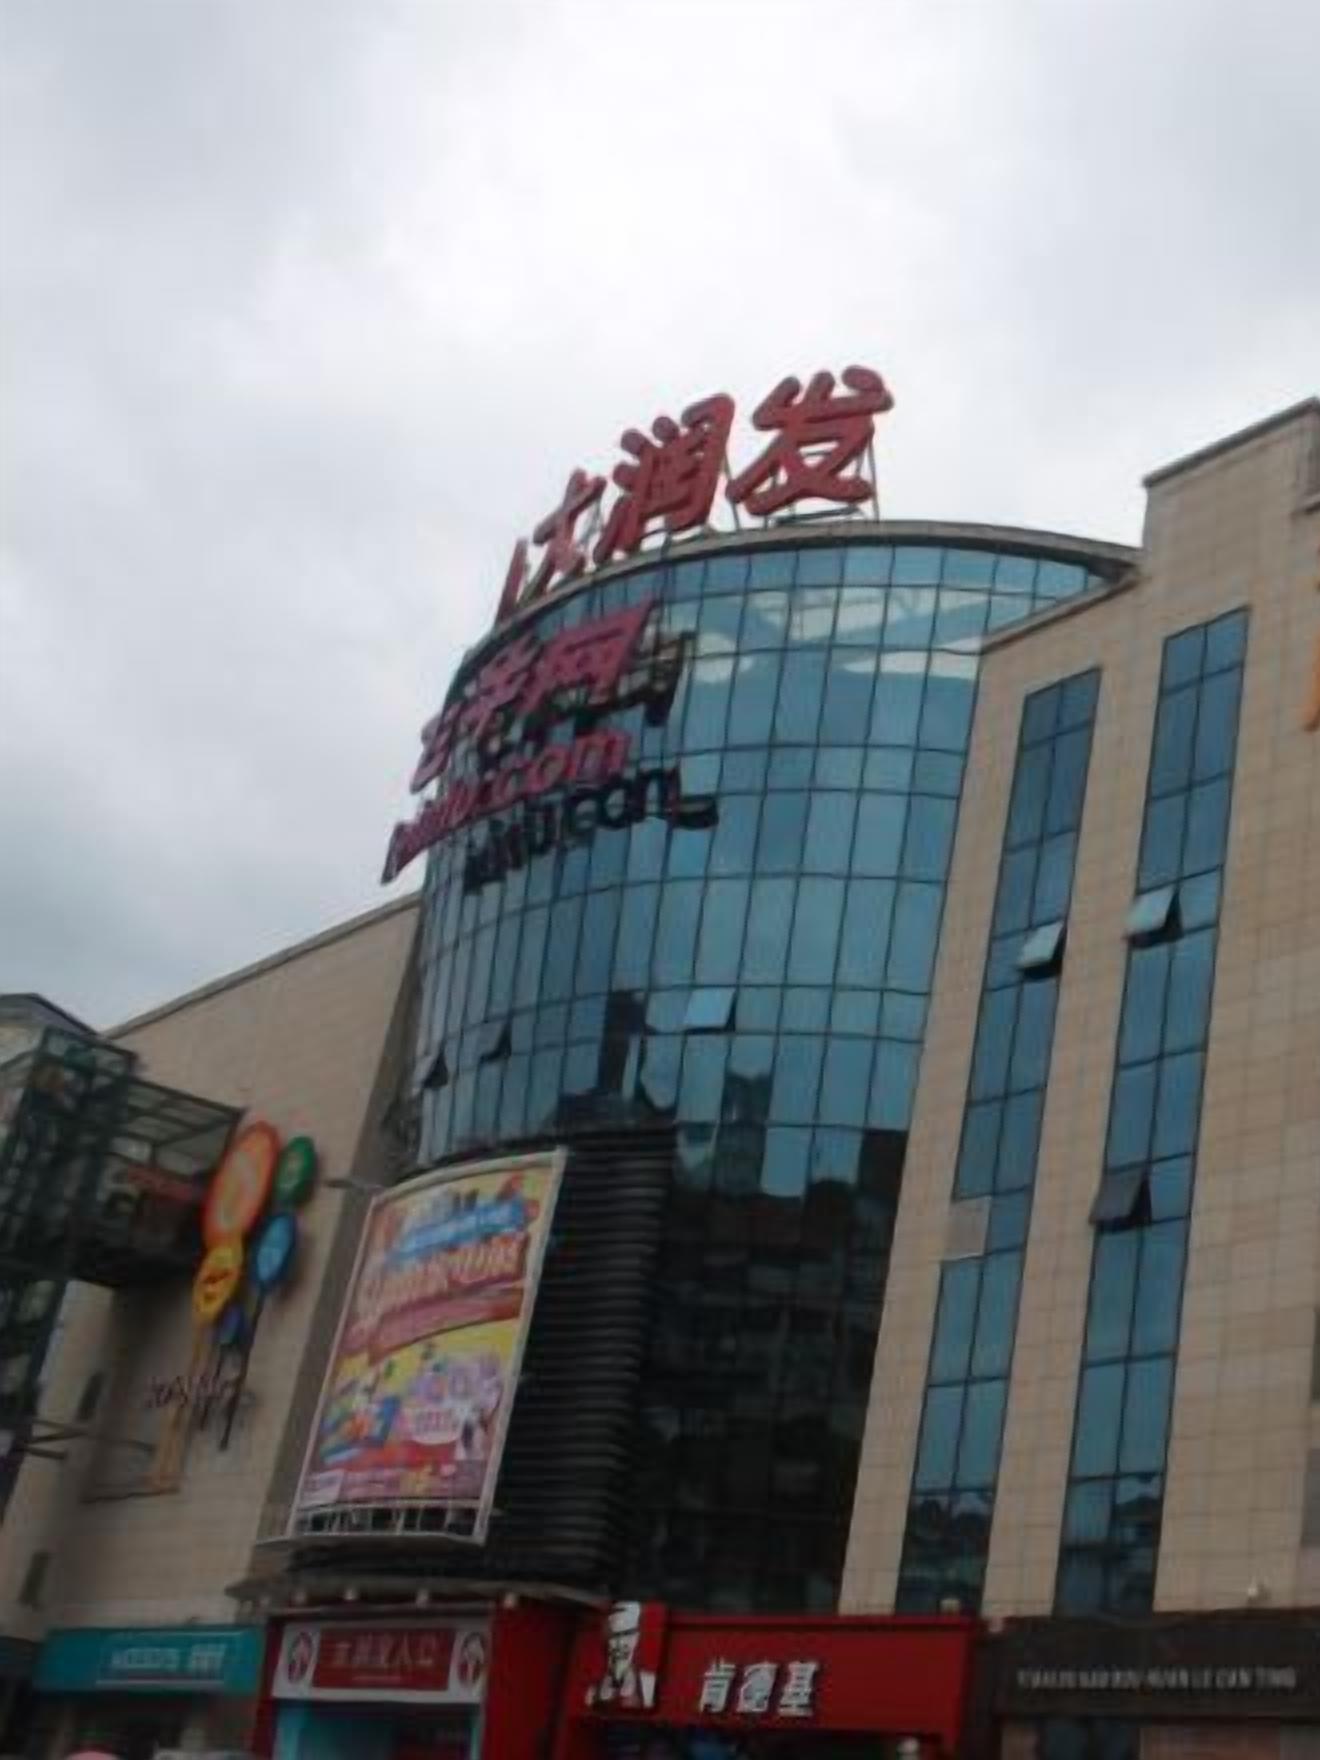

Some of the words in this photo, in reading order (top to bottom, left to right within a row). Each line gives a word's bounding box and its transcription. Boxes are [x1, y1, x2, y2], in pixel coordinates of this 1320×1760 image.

[515, 364, 894, 606] 大润发
[700, 1657, 819, 1717] 肯德基
